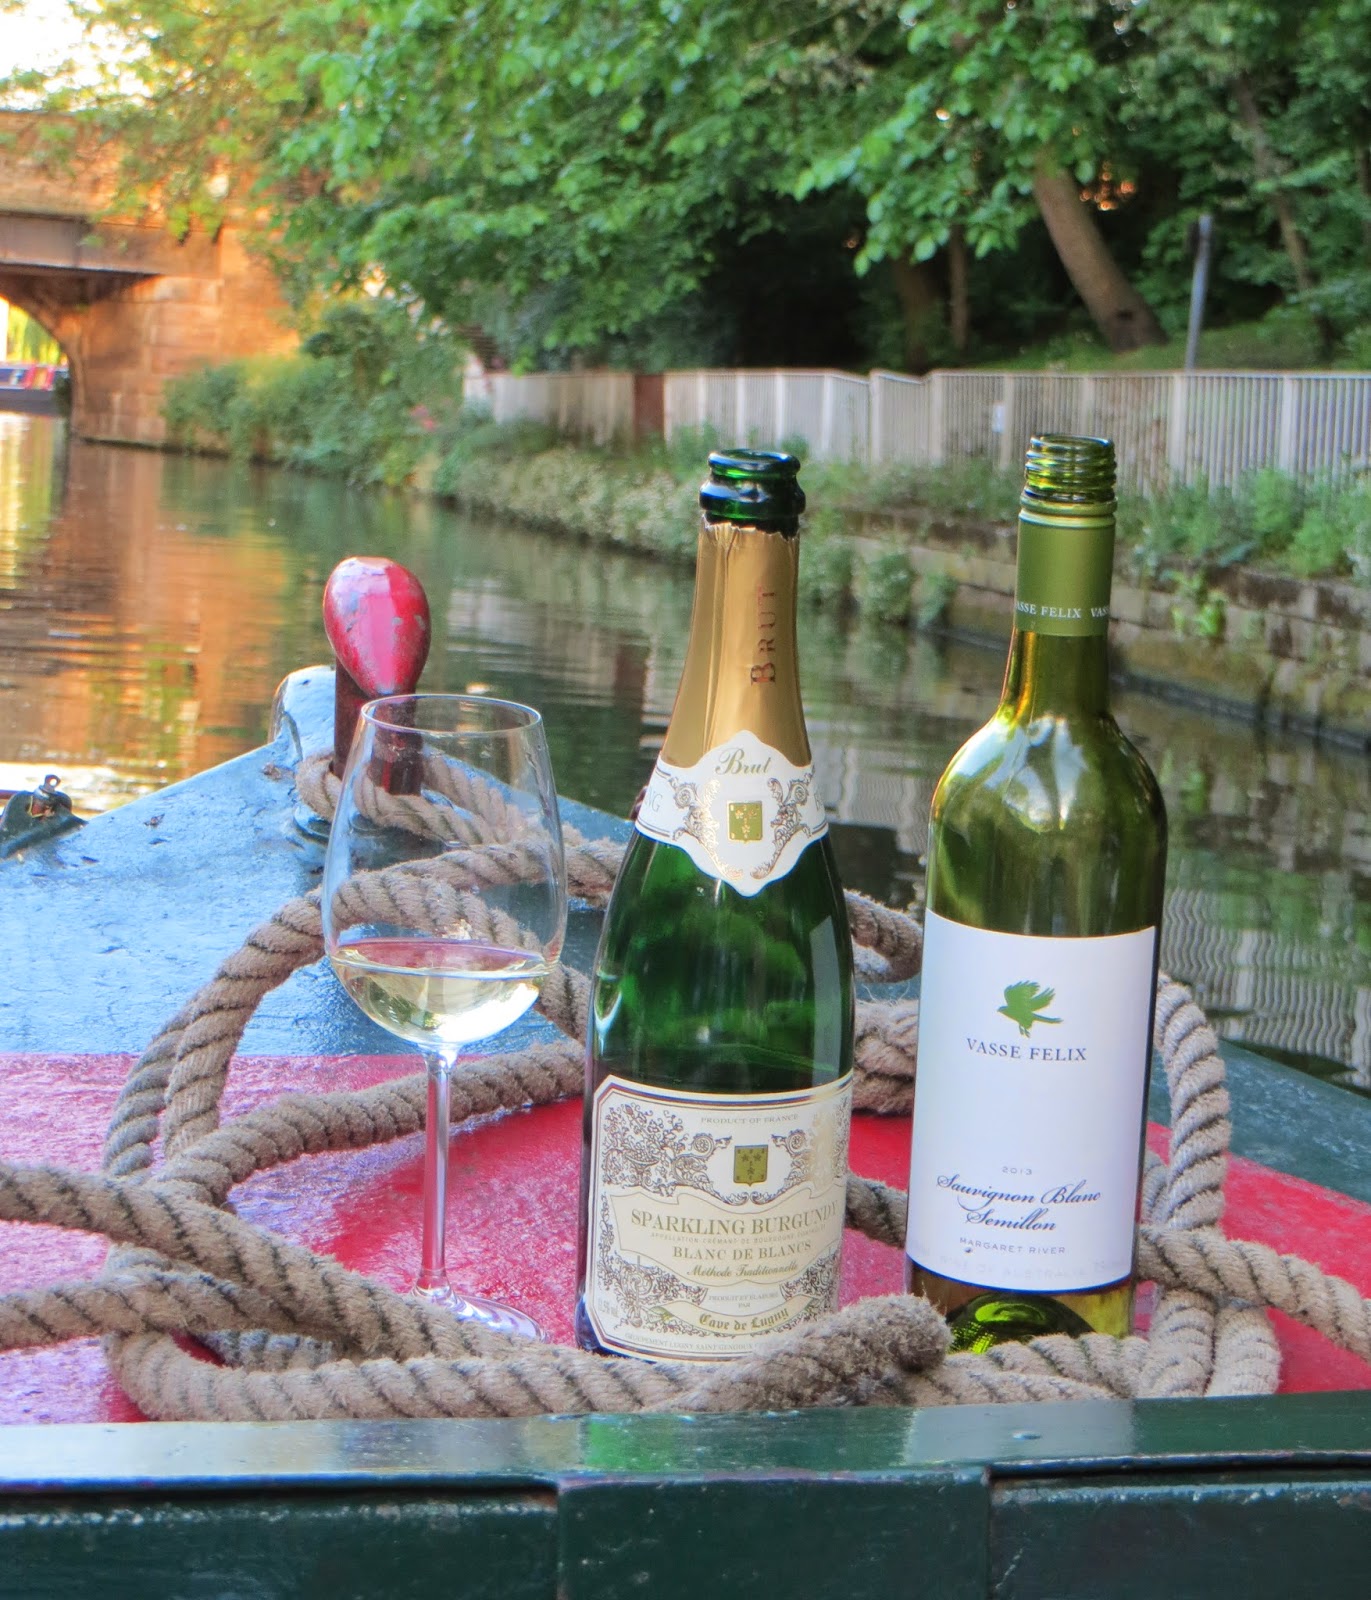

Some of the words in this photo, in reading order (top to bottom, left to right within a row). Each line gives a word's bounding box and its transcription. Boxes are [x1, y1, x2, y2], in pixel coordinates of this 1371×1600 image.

[1041, 606, 1082, 619] FELIX
[750, 586, 776, 685] BRUT
[715, 748, 772, 776] Brut
[966, 1038, 1022, 1059] VASSE
[1029, 1047, 1087, 1061] FELIX
[701, 1116, 746, 1124] PRODUCT
[764, 1113, 799, 1123] FRANCE
[1002, 1166, 1033, 1176] 2013
[936, 1174, 1035, 1212] Sauvignon
[1040, 1179, 1102, 1204] Blanc
[631, 1208, 745, 1235] SPARKLING
[752, 1199, 839, 1235] BURGUNDY
[966, 1208, 1057, 1231] Semillon
[673, 1246, 727, 1260] BLANC
[733, 1248, 753, 1260] DE
[759, 1240, 812, 1259] BLANCS
[959, 1237, 1023, 1253] MARGARET
[1029, 1246, 1066, 1255] RIVER
[699, 1313, 730, 1330] Cave
[733, 1319, 748, 1331] de
[751, 1307, 789, 1328] Lugny
